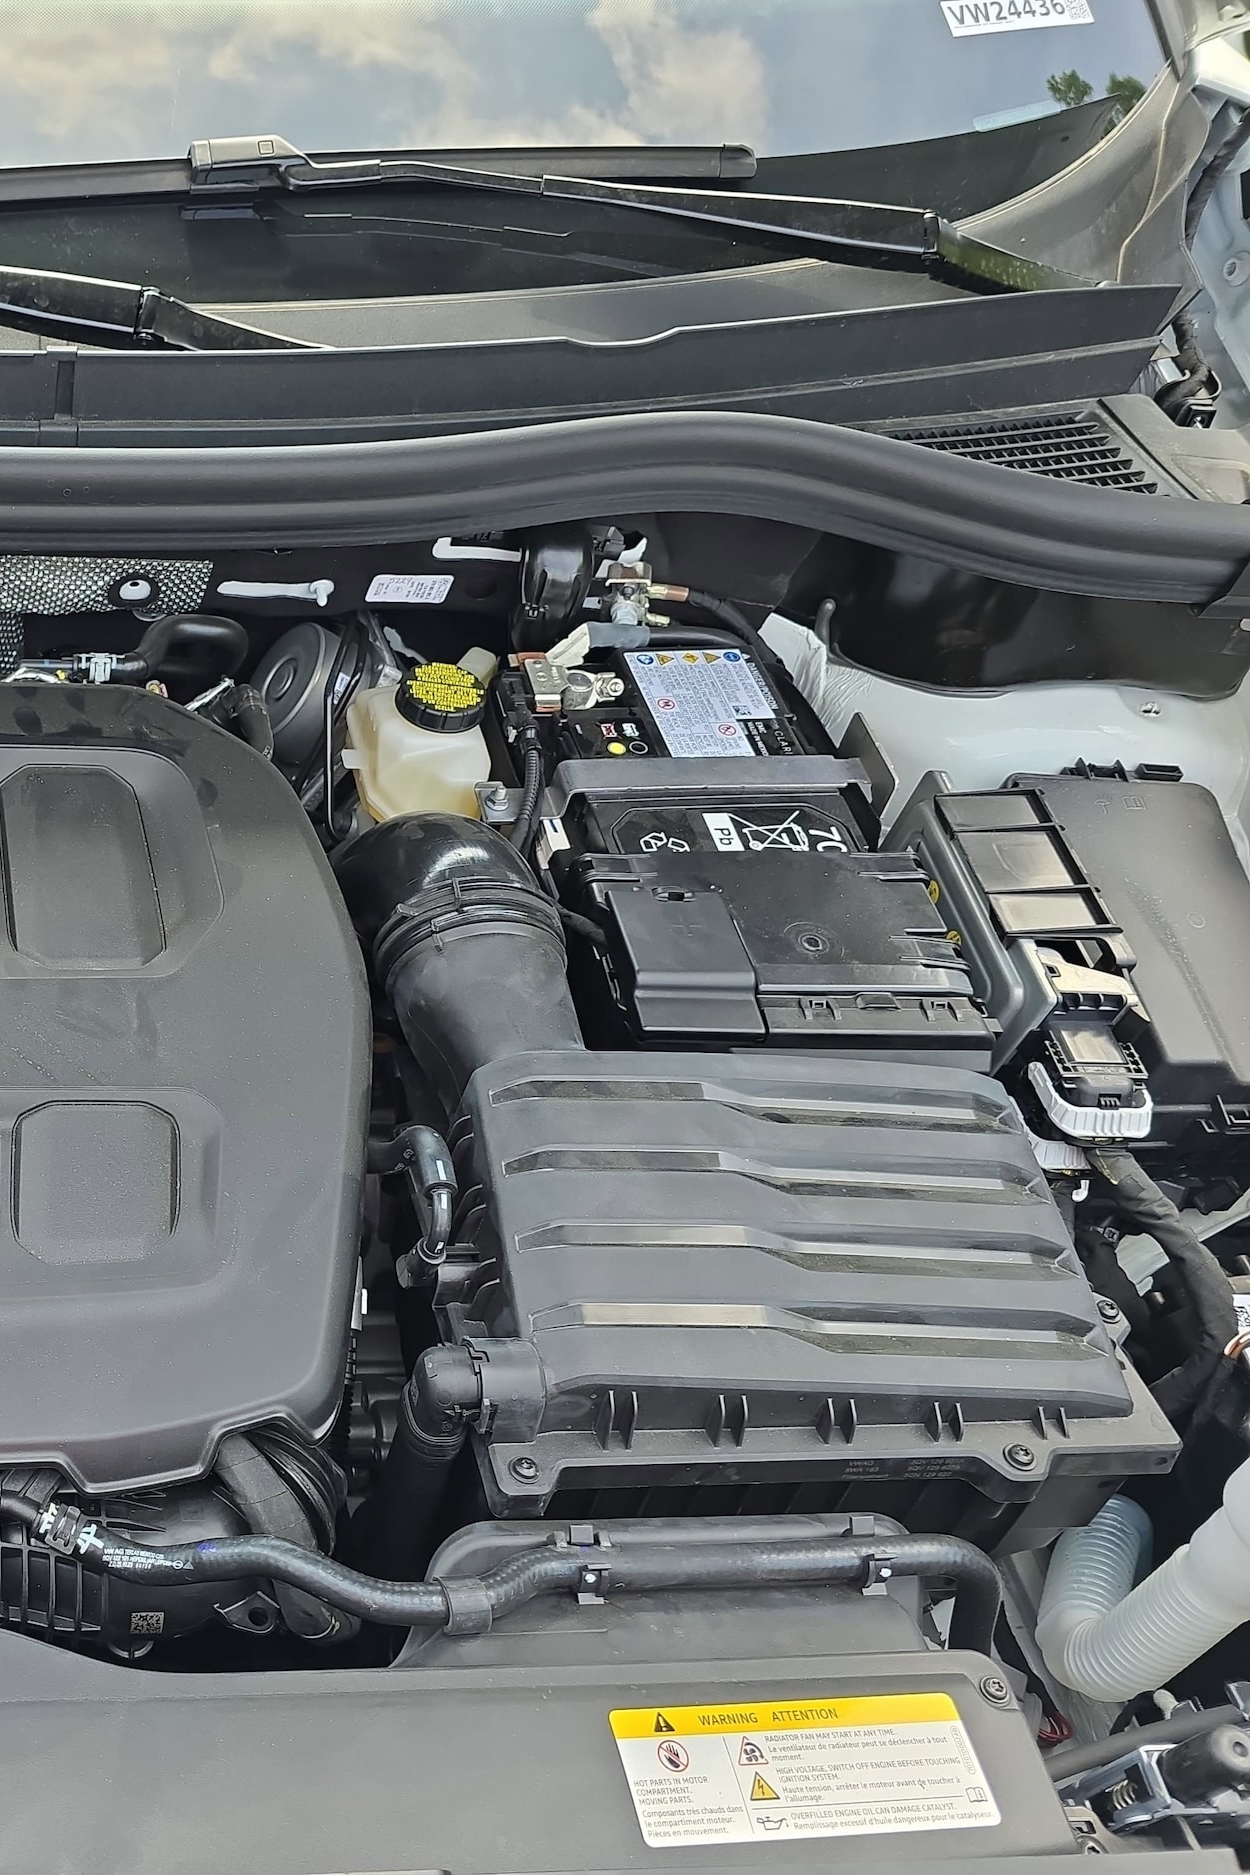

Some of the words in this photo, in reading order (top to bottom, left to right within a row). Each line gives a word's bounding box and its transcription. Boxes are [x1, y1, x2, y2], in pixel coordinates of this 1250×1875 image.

[948, 0, 1065, 25] VW24436
[748, 662, 779, 710] DANGER/POISON
[713, 828, 734, 846] Pb
[698, 1712, 758, 1726] WARNING
[771, 1707, 839, 1723] ATTENTION
[765, 1733, 799, 1743] RADIATOR
[801, 1733, 815, 1741] FAN
[816, 1732, 830, 1740] MAY
[831, 1731, 853, 1739] START
[779, 1744, 816, 1753] ventilateur
[861, 1739, 878, 1749] peut
[889, 1738, 925, 1746] déclencher
[776, 1767, 794, 1775] HIGH
[829, 1763, 854, 1772] SWITCH
[856, 1762, 870, 1770] OFF
[871, 1760, 897, 1769] ENGINE
[898, 1759, 924, 1767] BEFORE
[925, 1757, 961, 1766] TOUCHING
[634, 1779, 648, 1787] HOT
[650, 1778, 672, 1786] PARTS
[682, 1776, 708, 1784] MOTOR
[779, 1775, 811, 1783] IGNITION
[782, 1786, 804, 1794] Haute
[861, 1781, 868, 1789] le
[869, 1780, 895, 1789] moteur
[927, 1776, 953, 1785] toucher
[955, 1775, 960, 1783] à
[639, 1797, 668, 1805] MOVING
[642, 1809, 686, 1818] Composants
[701, 1806, 726, 1814] chauds
[790, 1811, 834, 1820] OVERFILLED
[835, 1810, 862, 1818] ENGINE
[875, 1807, 890, 1815] CAN
[890, 1805, 922, 1814] DAMAGE
[645, 1820, 652, 1828] le
[653, 1818, 707, 1828] compartiment
[794, 1820, 839, 1830] Remplissage
[840, 1818, 867, 1827] excessif
[893, 1815, 931, 1824] dangereux
[931, 1813, 948, 1822] pour
